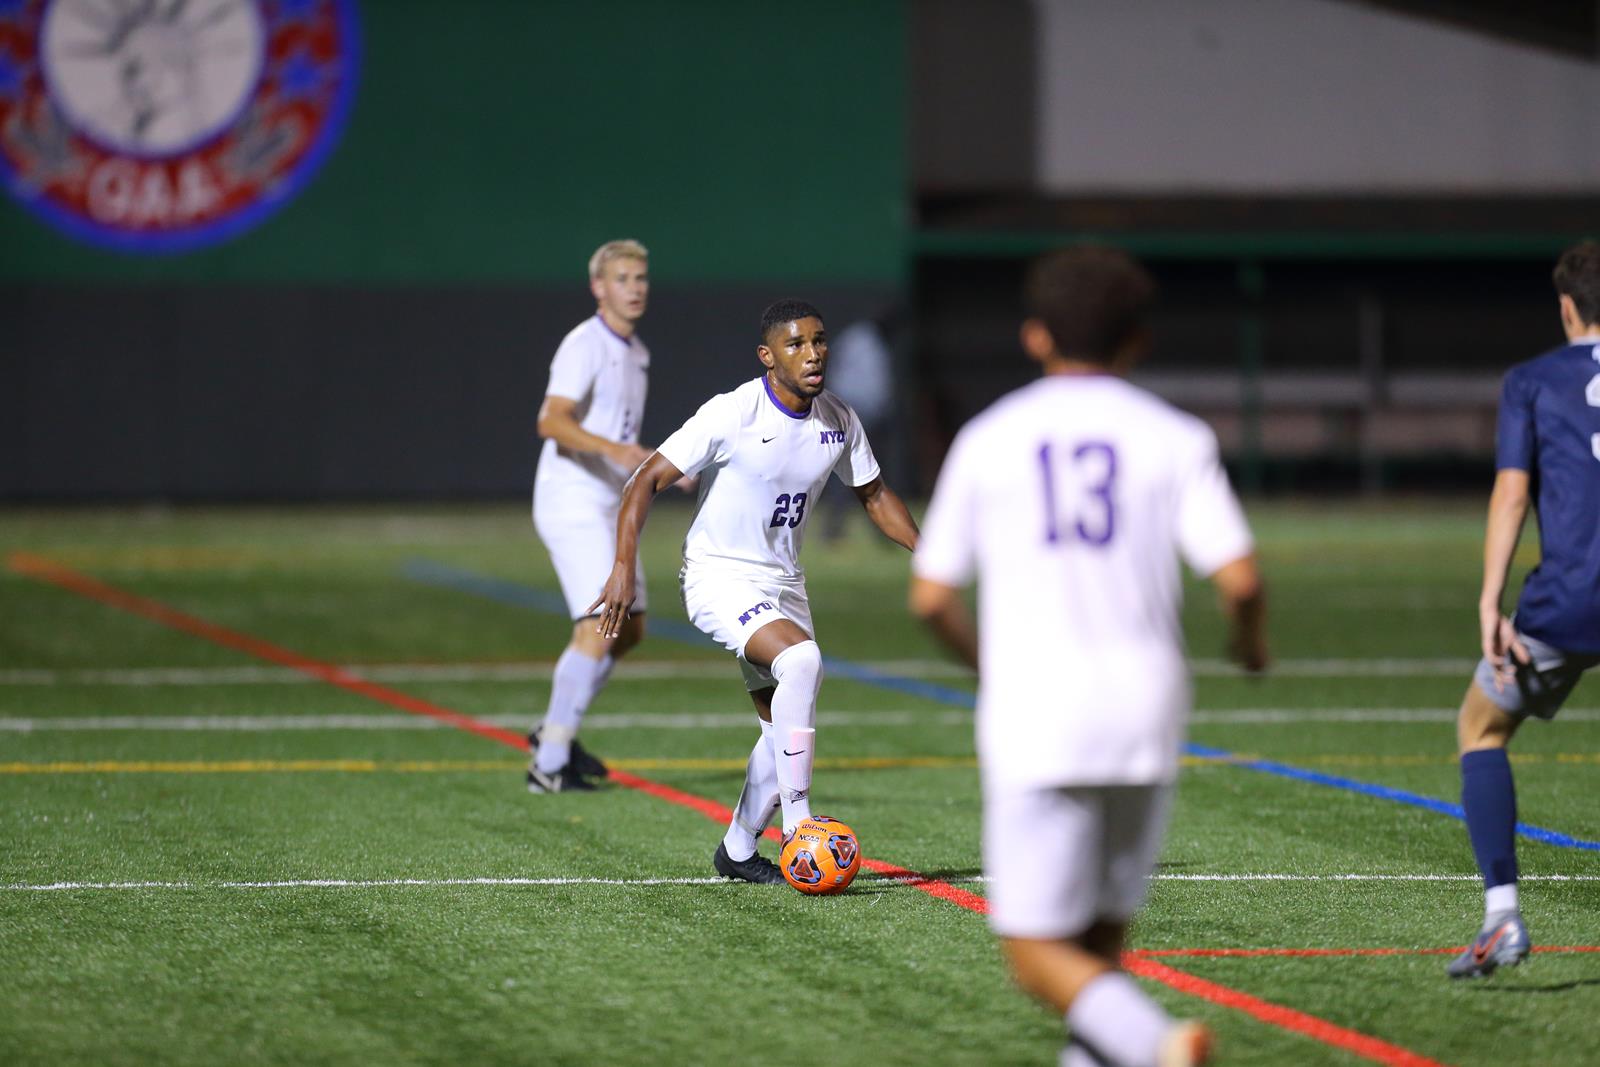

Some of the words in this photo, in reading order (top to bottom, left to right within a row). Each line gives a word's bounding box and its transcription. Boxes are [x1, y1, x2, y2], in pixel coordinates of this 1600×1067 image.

[820, 431, 845, 445] NYU
[1036, 438, 1119, 548] 13
[769, 493, 807, 529] 23
[738, 602, 773, 626] NYU
